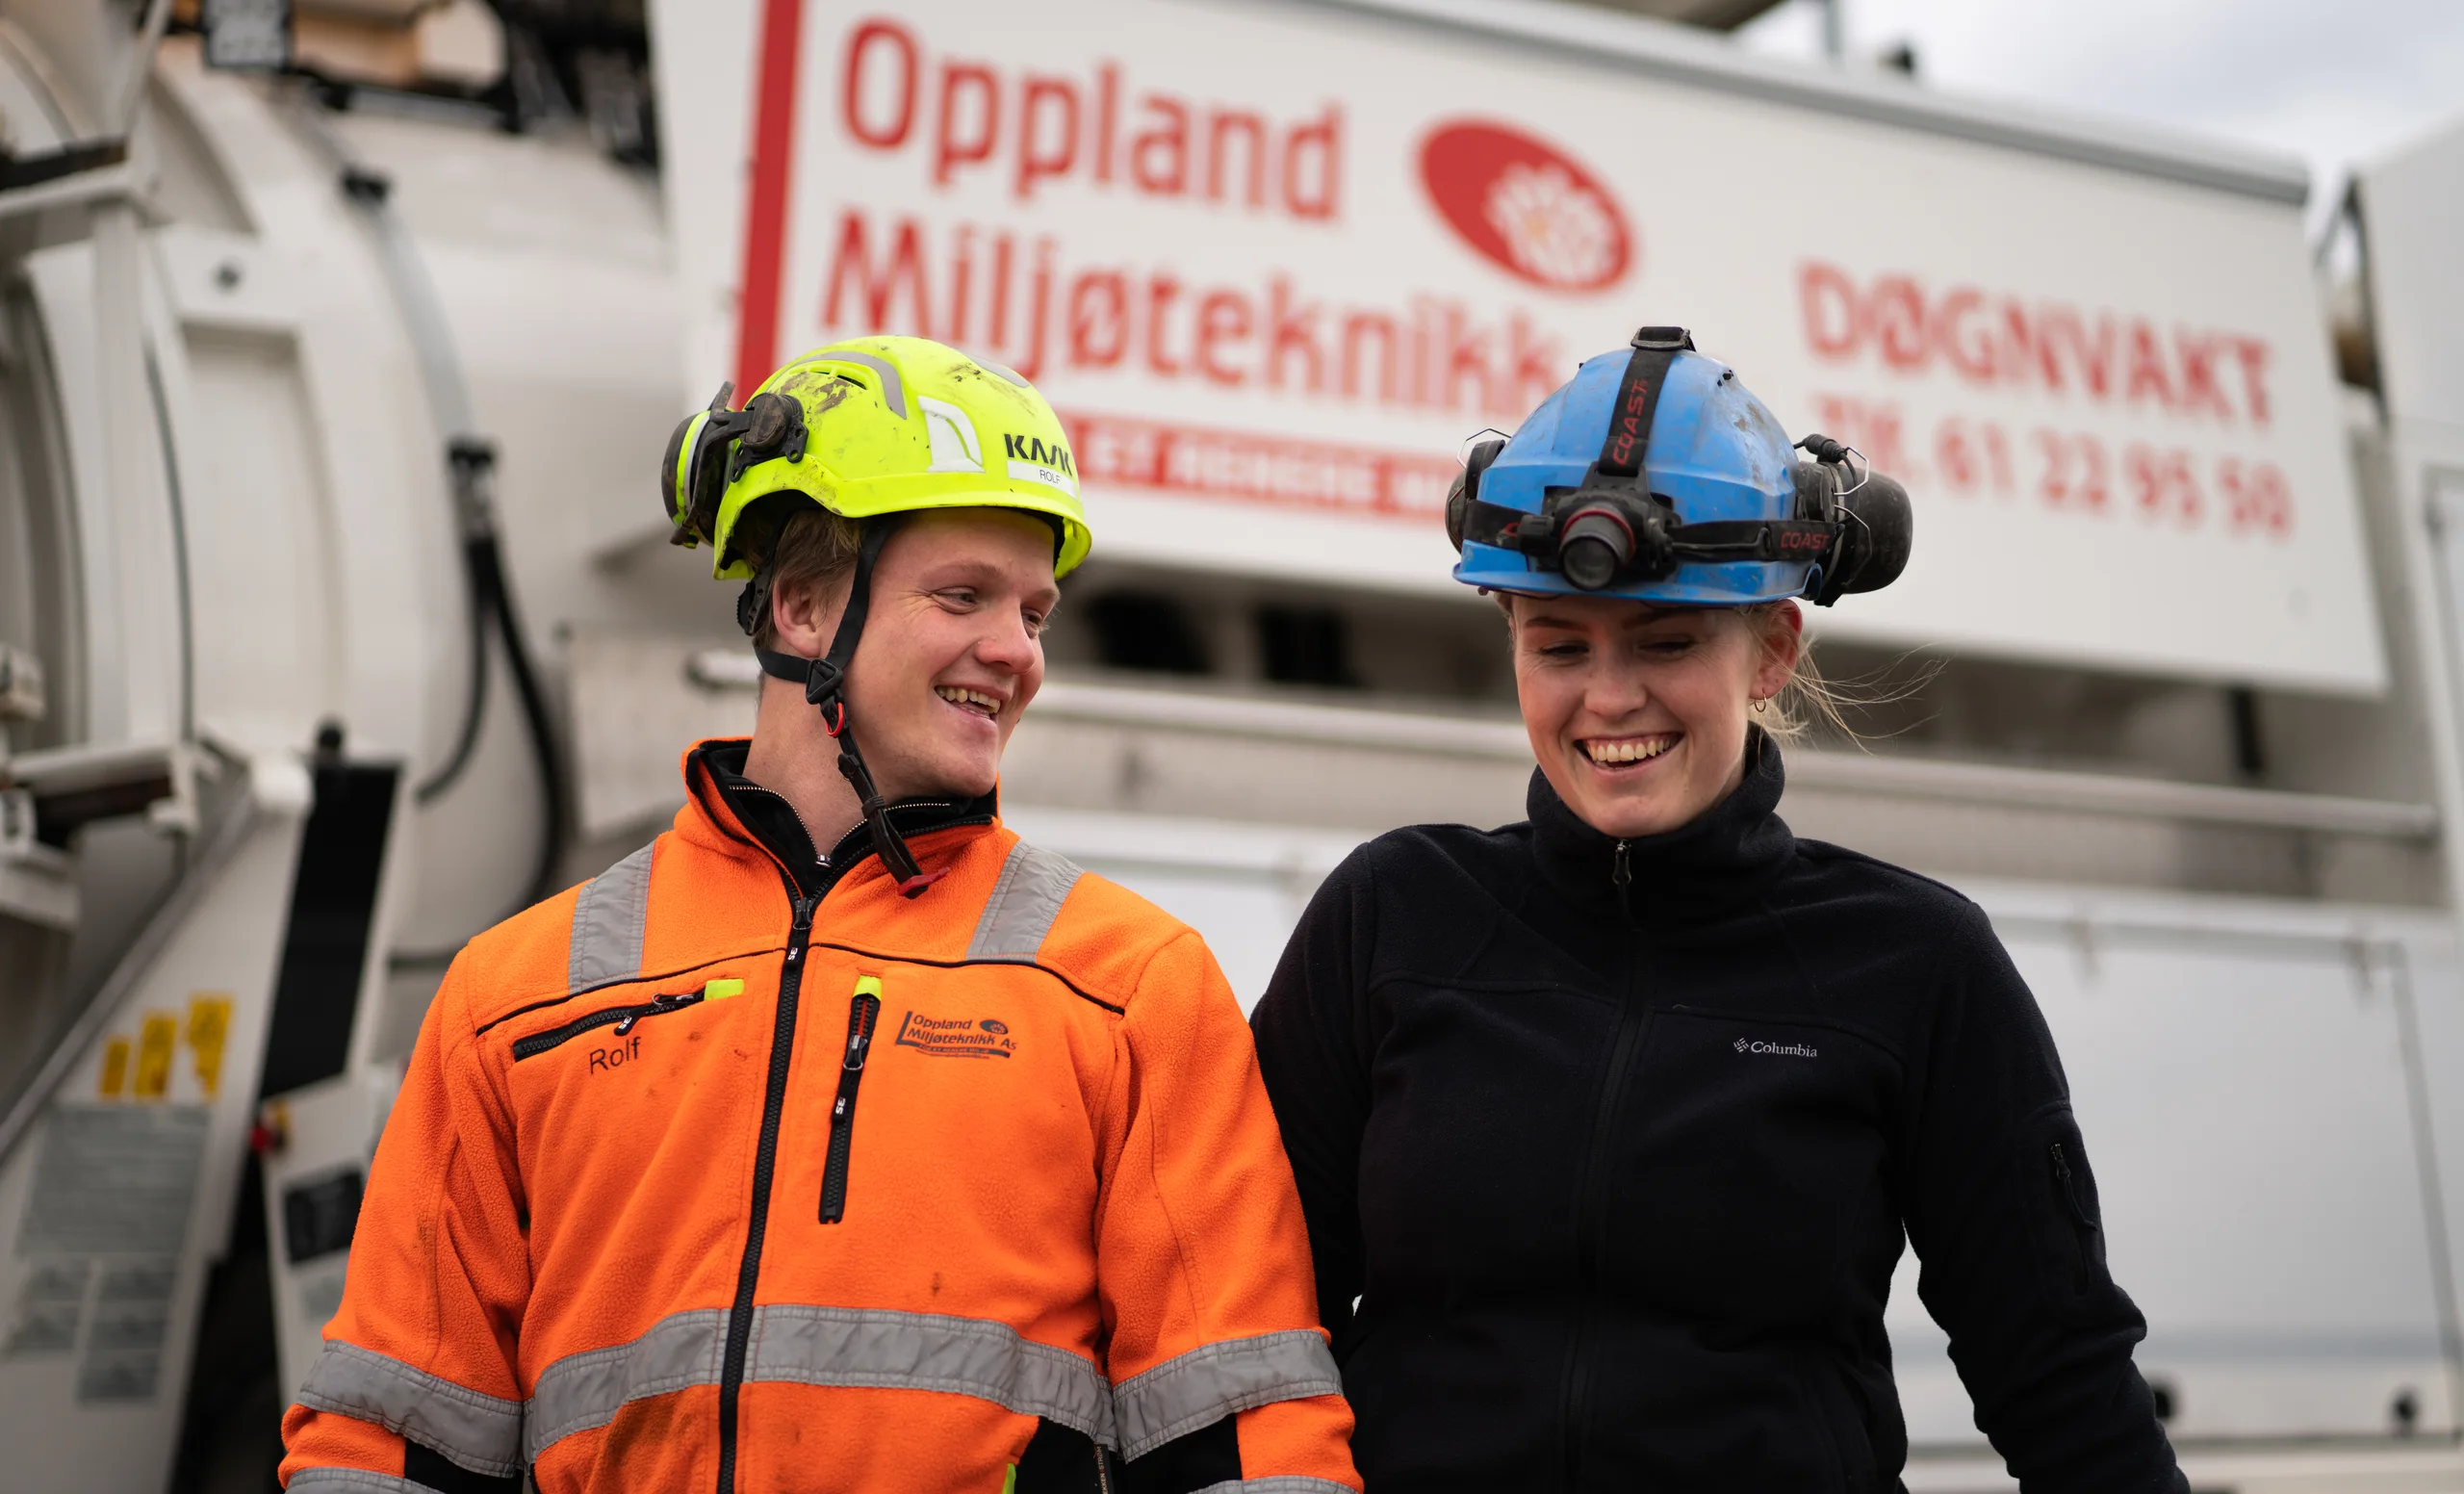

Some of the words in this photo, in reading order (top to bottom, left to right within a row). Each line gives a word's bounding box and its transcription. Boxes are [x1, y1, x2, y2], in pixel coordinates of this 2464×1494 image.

[840, 16, 1347, 223] Oppland
[821, 205, 1563, 417] Miljøteknikk
[1797, 260, 2273, 427] DØGNVAKT
[1613, 378, 1648, 466] COAST
[1004, 433, 1072, 477] KASK
[1931, 414, 2016, 496] 61
[2032, 425, 2113, 517] 22
[2120, 437, 2203, 536] 95
[1040, 469, 1061, 484] ROLF
[1780, 530, 1830, 550] COAST
[908, 1027, 995, 1045] Miljøteknikk
[913, 1015, 972, 1030] Oppland
[590, 1036, 641, 1075] Rolf
[1751, 1041, 1817, 1058] Columbia
